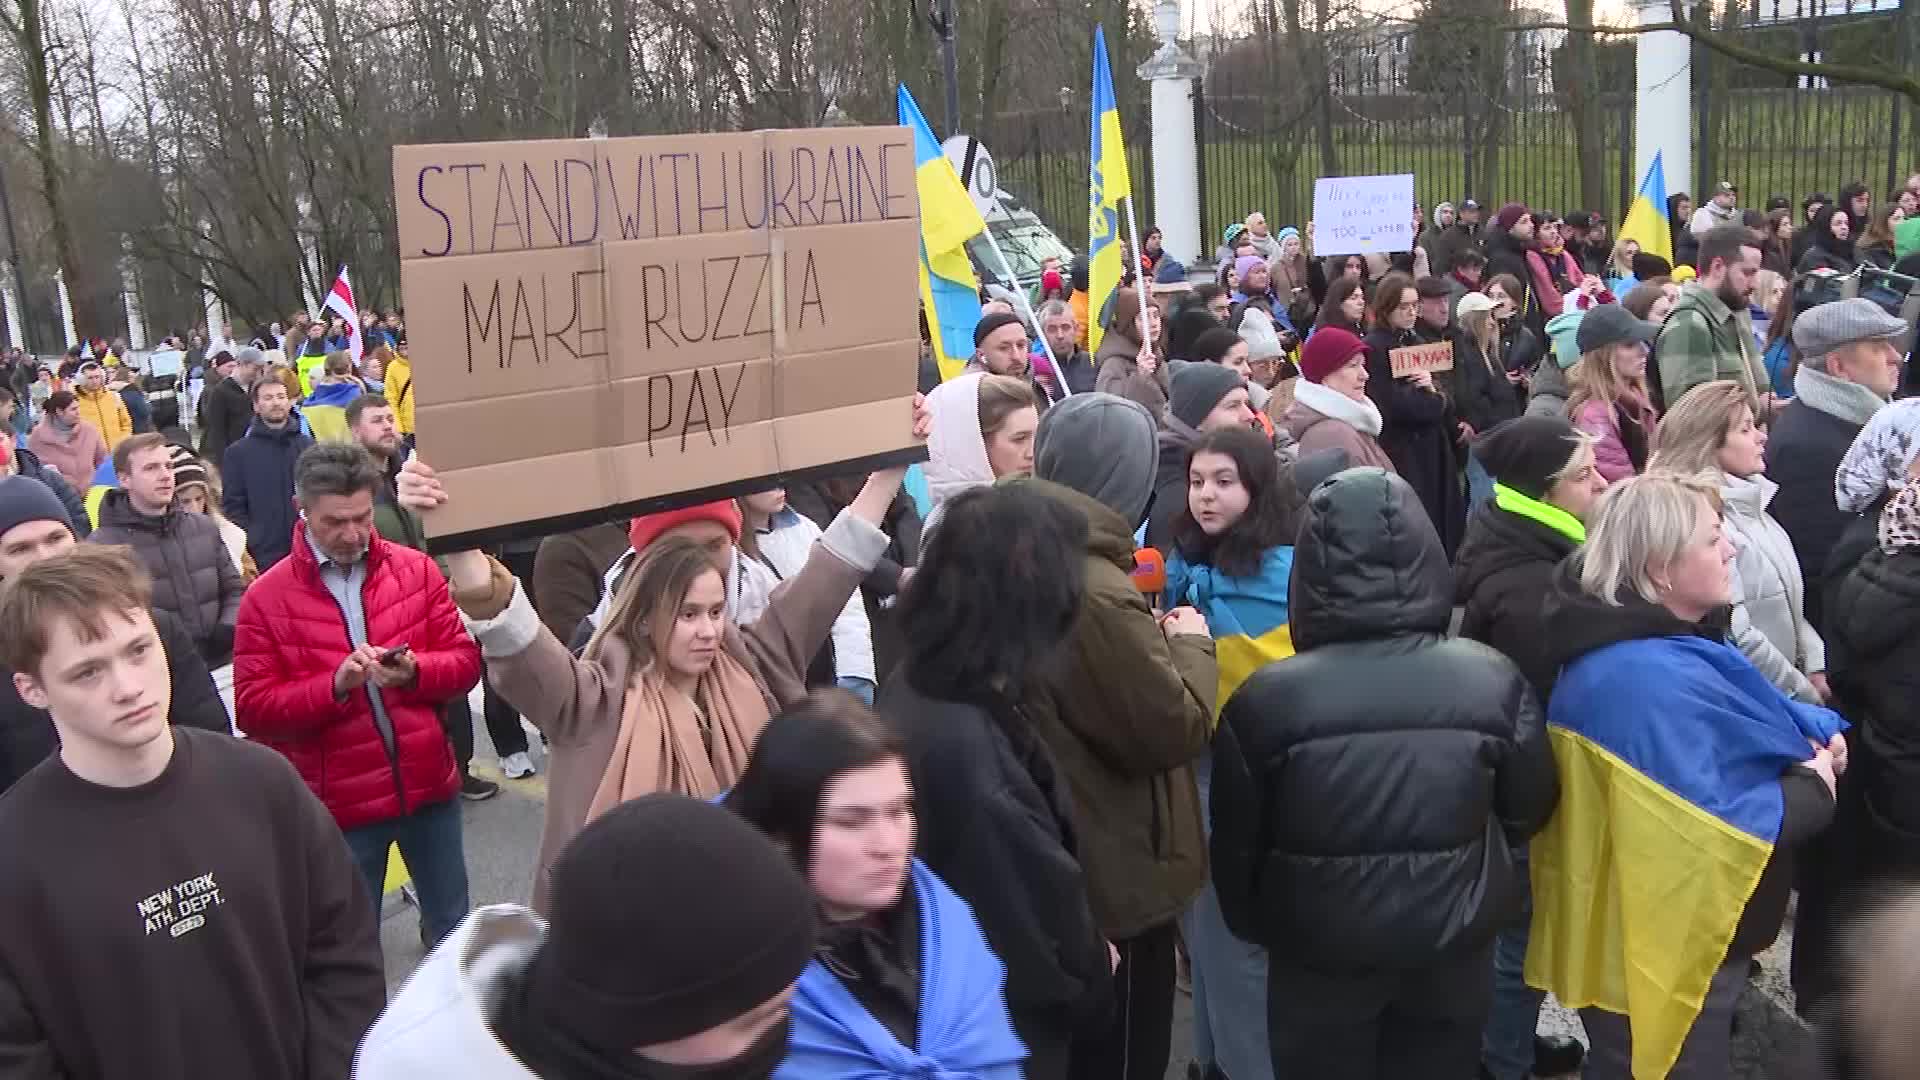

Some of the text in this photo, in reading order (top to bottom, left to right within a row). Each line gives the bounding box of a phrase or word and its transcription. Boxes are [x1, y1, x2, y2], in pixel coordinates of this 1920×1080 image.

[418, 143, 914, 257] STAND WITH UKRAINE
[462, 248, 826, 373] MAKE RUZZIA
[646, 362, 746, 458] PAY
[137, 872, 217, 915] NEW YORK
[145, 890, 225, 935] ATH. DEPT.
